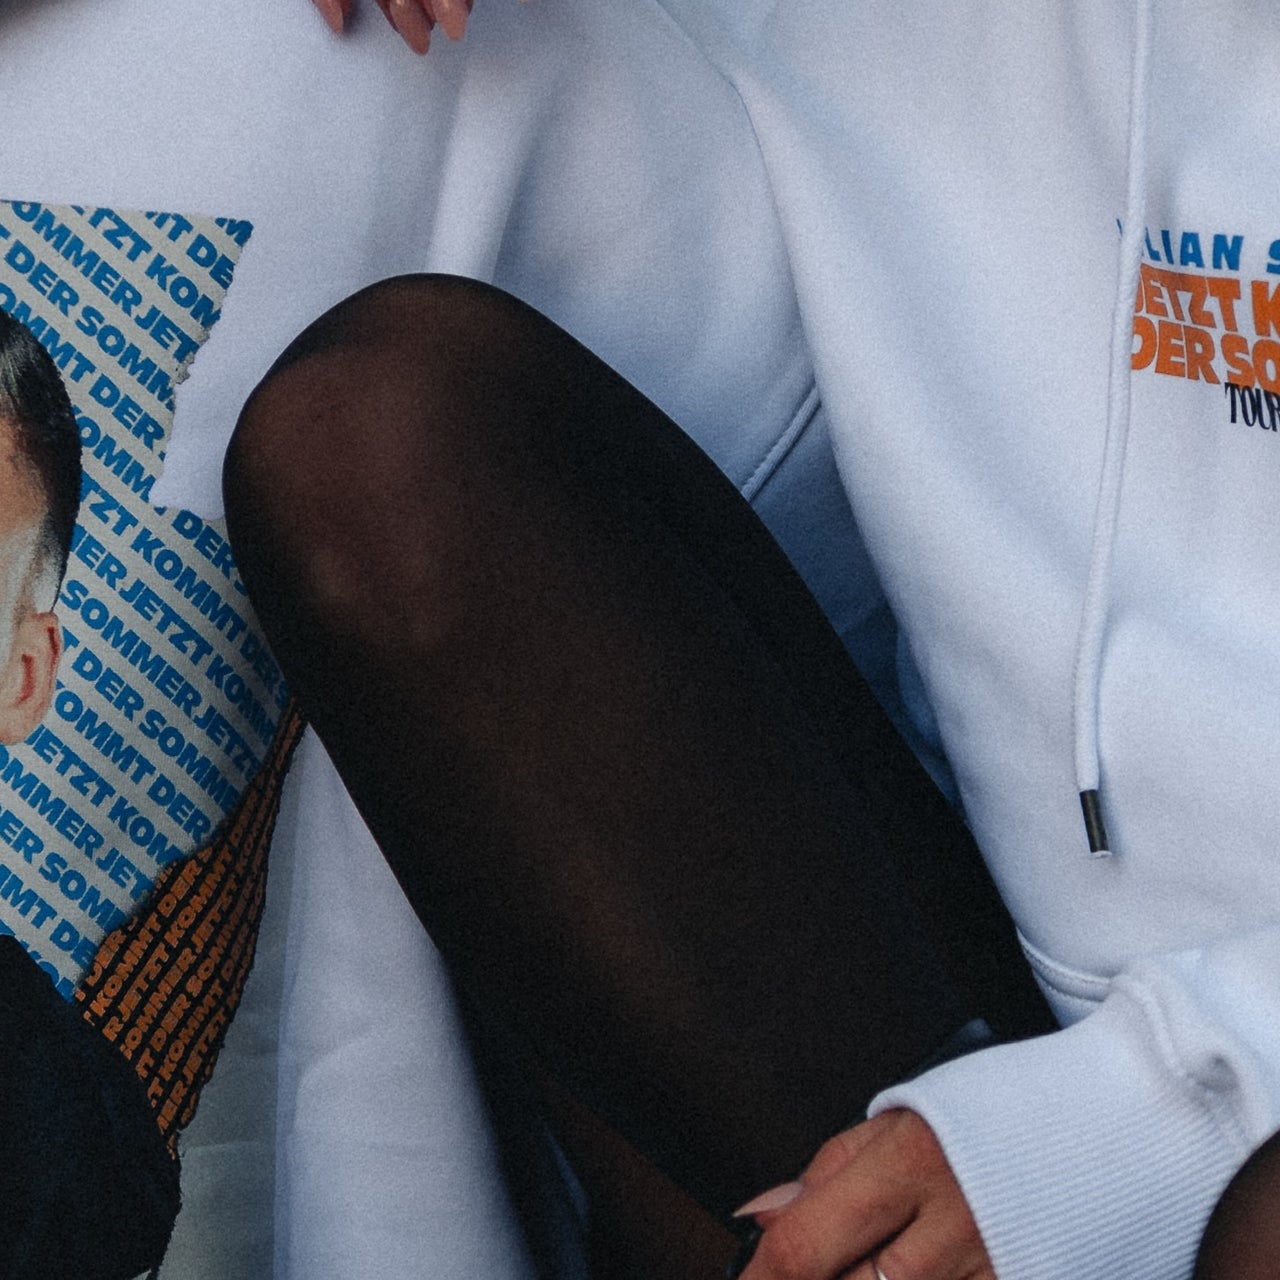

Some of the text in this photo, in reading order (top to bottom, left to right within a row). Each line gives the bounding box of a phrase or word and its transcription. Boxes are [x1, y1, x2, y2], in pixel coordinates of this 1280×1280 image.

[74, 206, 152, 261] TZT
[1116, 218, 1244, 271] LIAN
[5, 241, 79, 315] DER
[76, 306, 174, 411] SOMM
[1131, 316, 1220, 385] DER
[89, 374, 164, 449] DER
[119, 579, 214, 665] JETZT
[131, 528, 248, 643] KOMMT
[57, 580, 202, 718] SOMMER
[72, 648, 145, 721] DER
[55, 681, 156, 784] OMMT
[147, 774, 212, 845] DER
[89, 912, 161, 1017] KOMMT
[157, 859, 202, 917] DER
[113, 942, 169, 1023] JETZT
[164, 845, 232, 947] KOMMT
[150, 993, 191, 1052] DER
